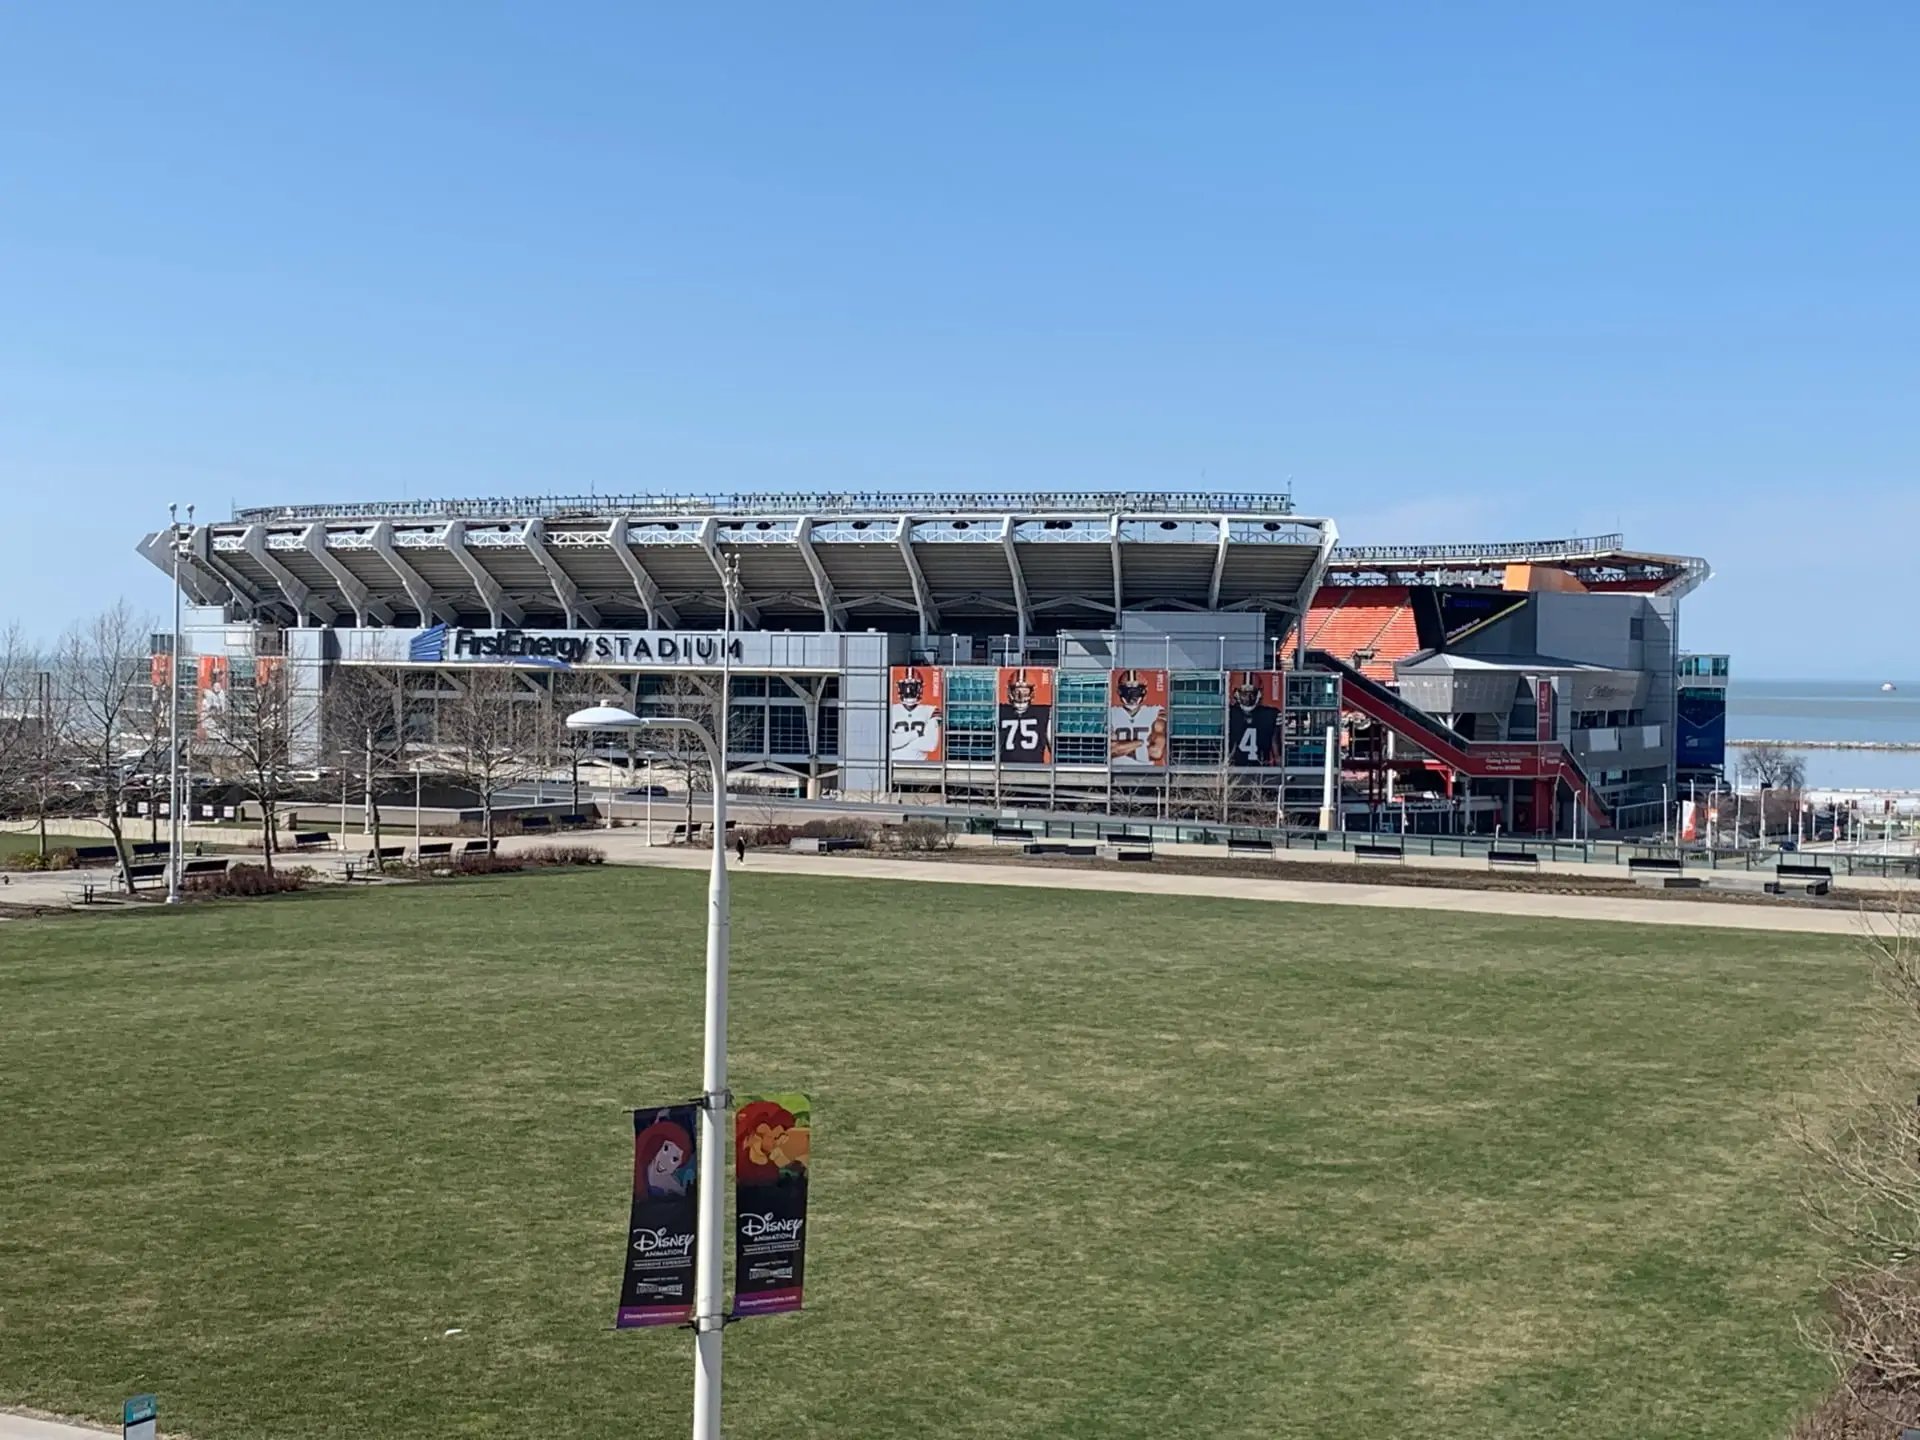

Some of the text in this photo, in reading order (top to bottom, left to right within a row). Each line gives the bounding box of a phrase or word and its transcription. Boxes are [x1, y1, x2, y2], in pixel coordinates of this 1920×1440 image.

[454, 629, 741, 664] FirstEnergy STADIUM
[1001, 718, 1038, 750] 75
[1238, 727, 1258, 761] 4
